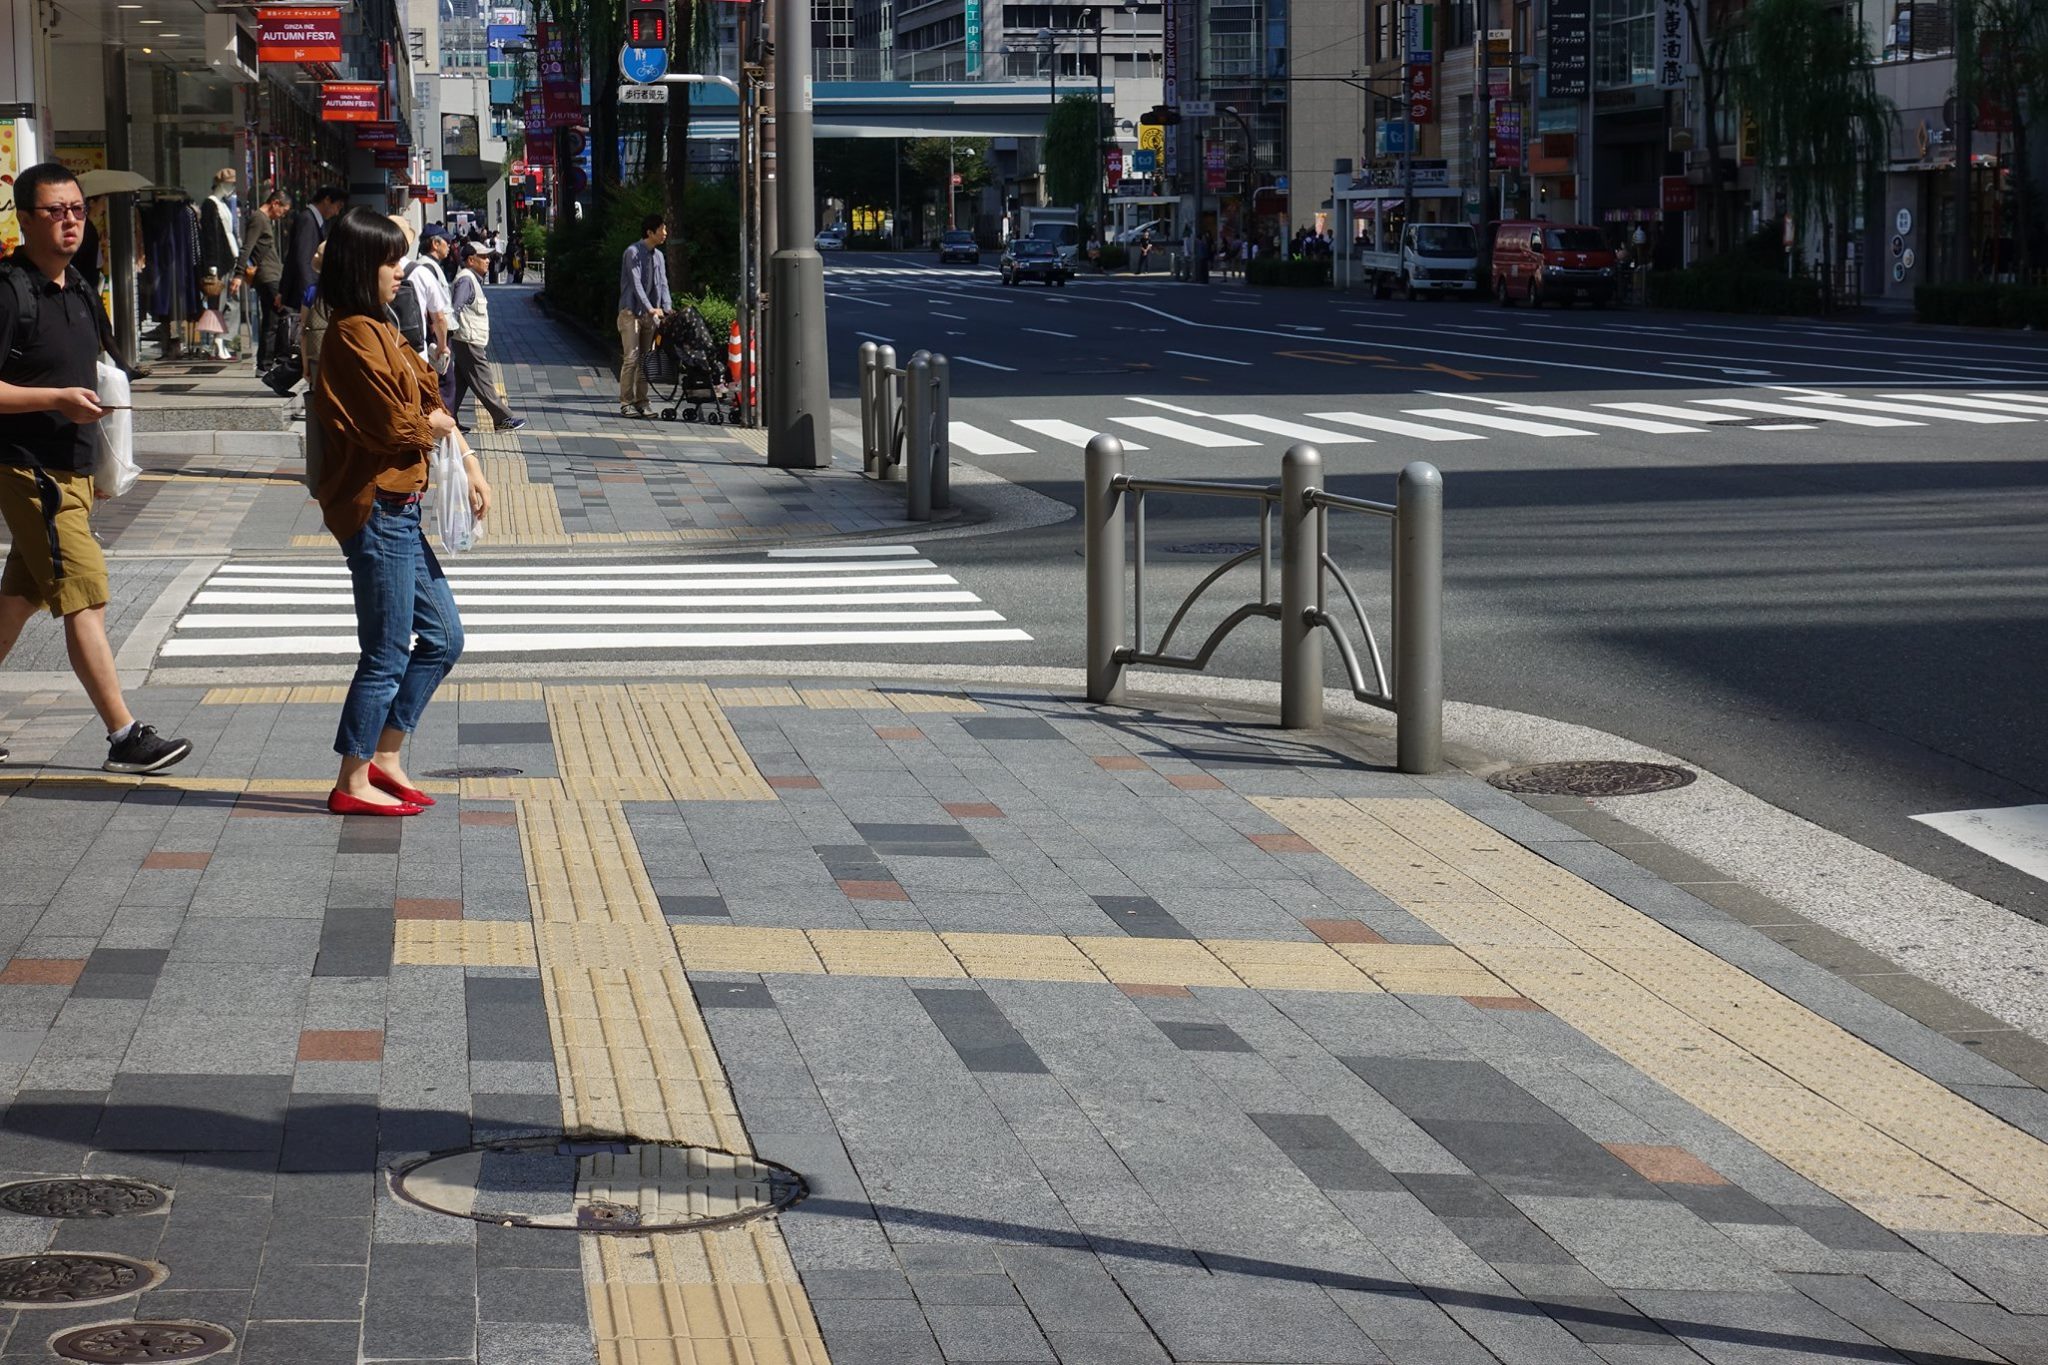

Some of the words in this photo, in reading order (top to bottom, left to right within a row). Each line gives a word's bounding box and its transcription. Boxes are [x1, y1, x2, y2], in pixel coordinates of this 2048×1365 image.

[263, 31, 305, 41] AUTUMN
[307, 31, 336, 41] FESTA
[625, 90, 665, 100] 歩行者優先
[1928, 129, 1943, 144] THE
